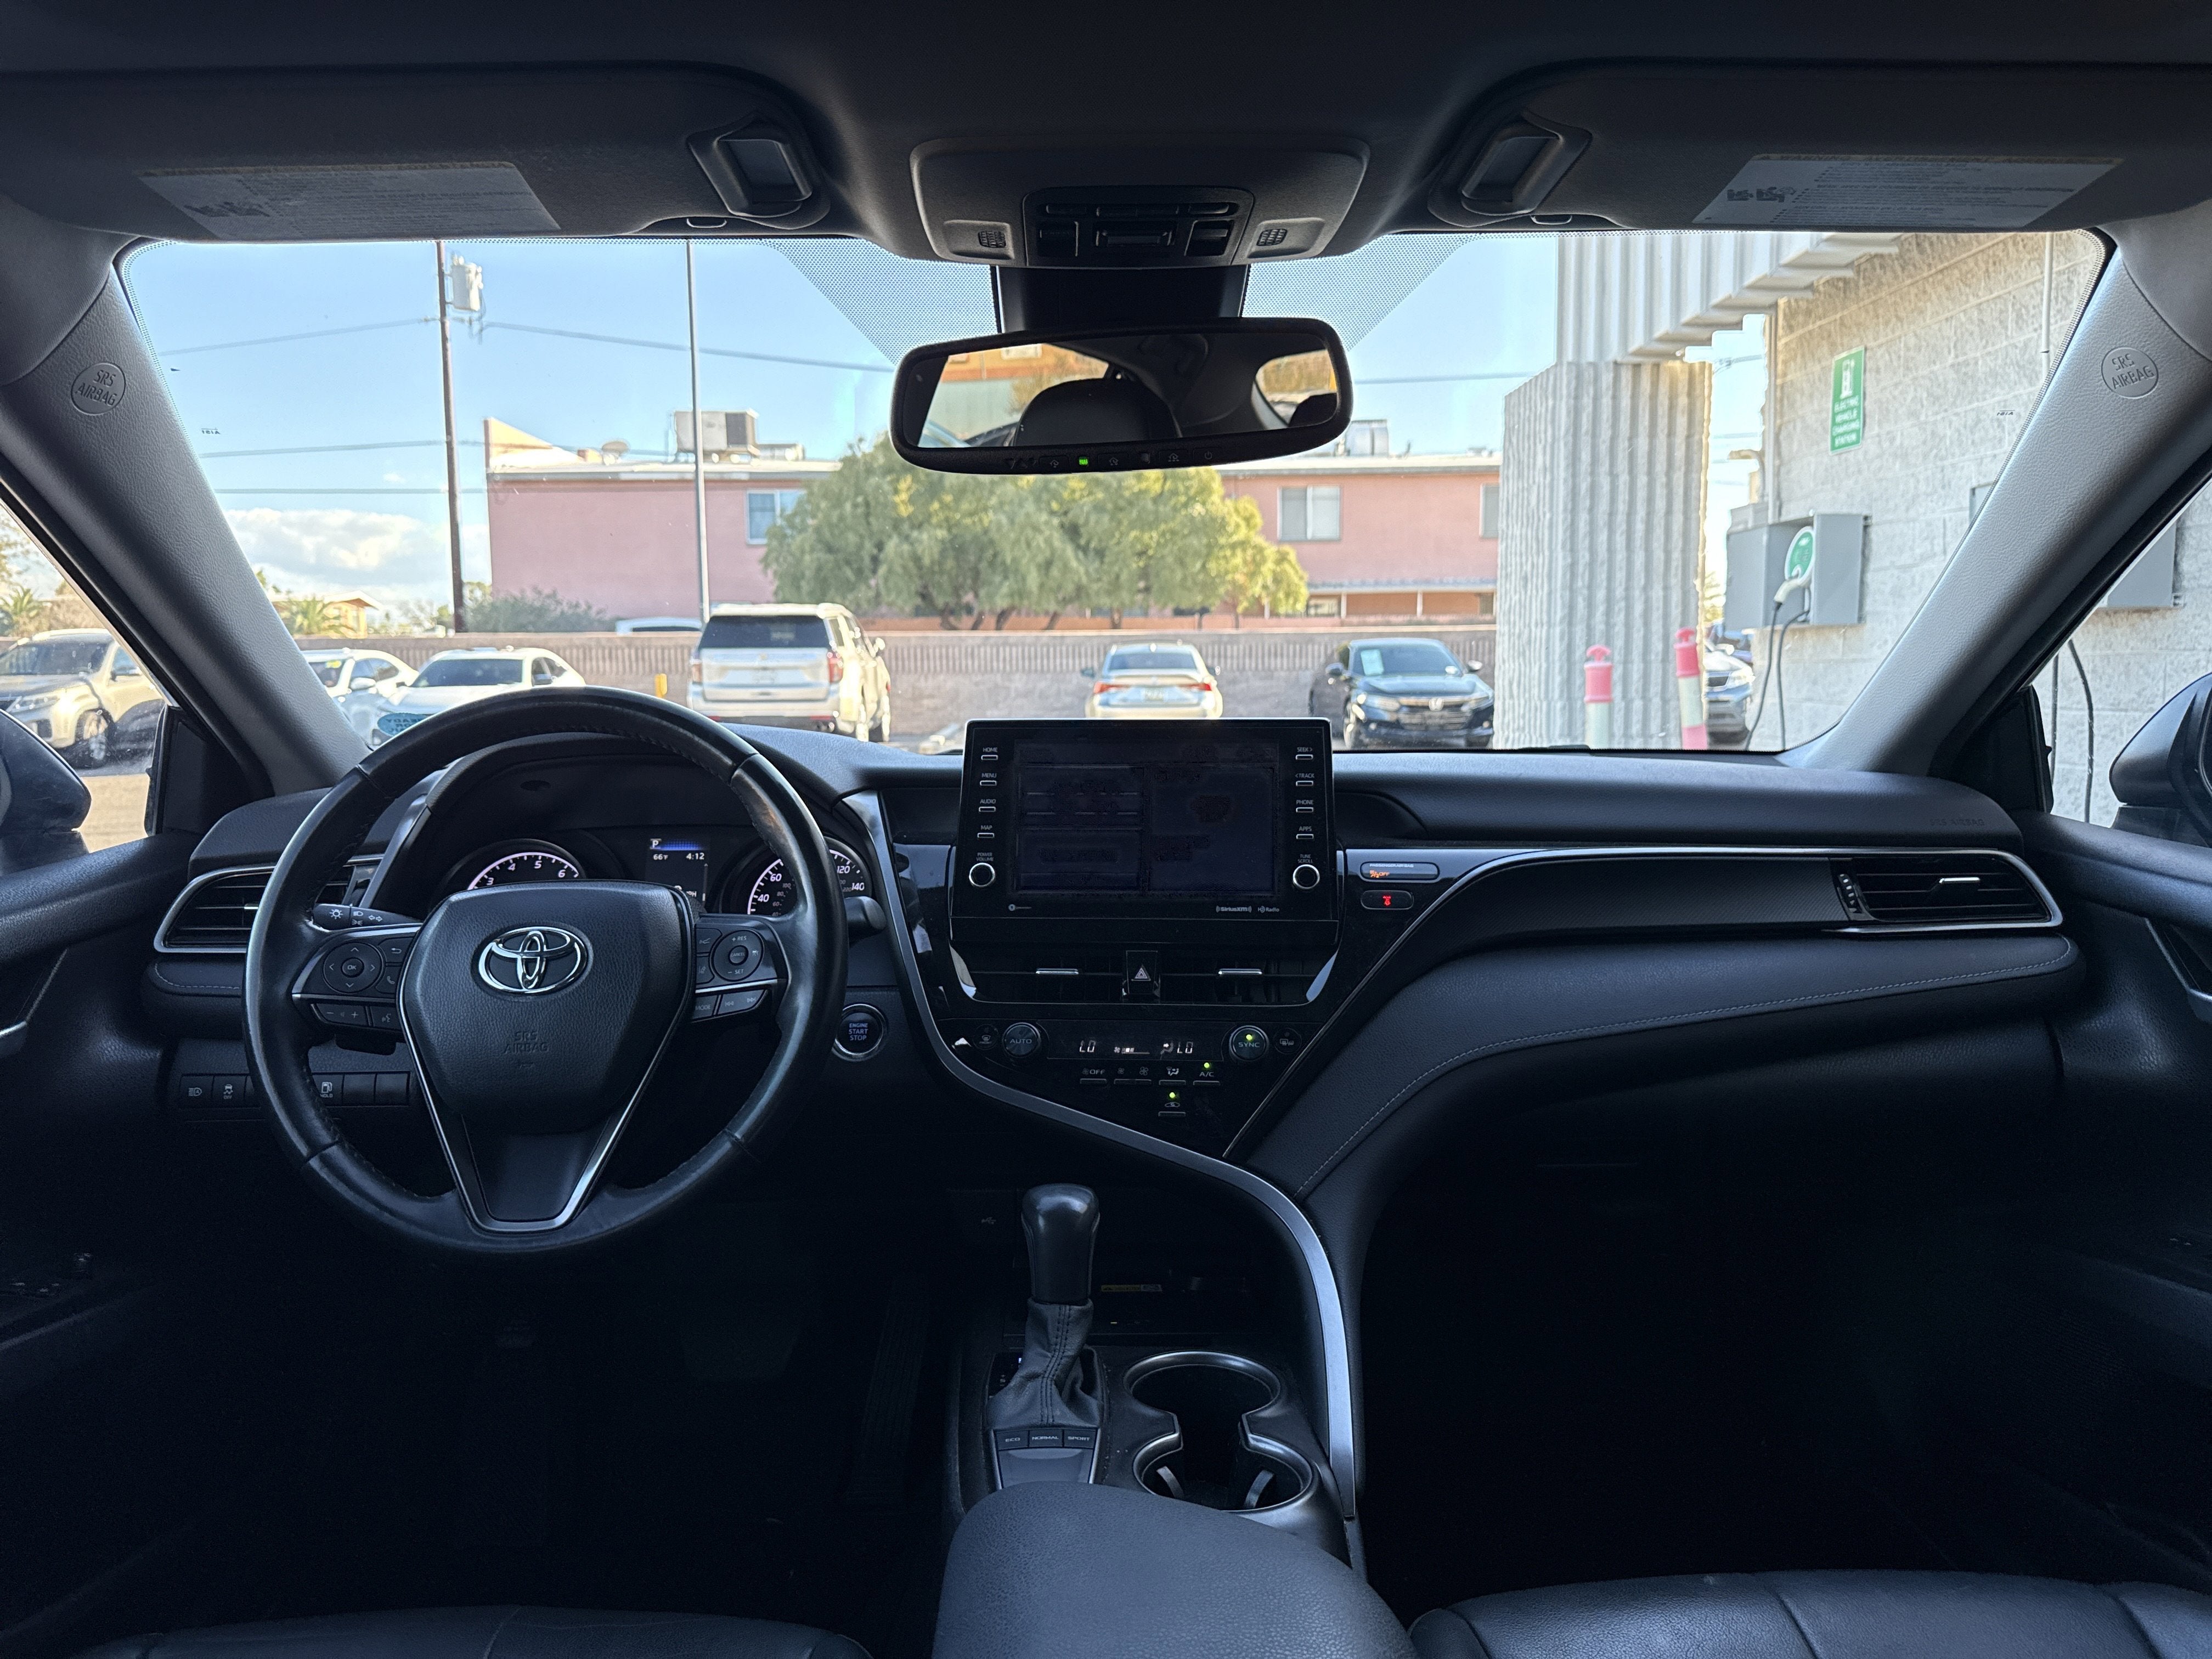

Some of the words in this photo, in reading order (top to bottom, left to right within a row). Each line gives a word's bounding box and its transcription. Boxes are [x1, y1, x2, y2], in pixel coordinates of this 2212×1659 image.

[2111, 353, 2135, 371] SRS
[93, 369, 116, 388] SRS
[2111, 365, 2155, 390] AIRBAG
[75, 382, 118, 407] AIRBAG
[652, 840, 659, 848] P
[534, 860, 542, 869] 5
[558, 869, 566, 878] 6
[837, 865, 850, 874] 120
[486, 877, 494, 885] 3
[770, 873, 782, 882] 60
[851, 882, 865, 891] 140
[757, 894, 770, 902] 40
[515, 1031, 539, 1041] SRS
[502, 1042, 549, 1054] AIRBAG
